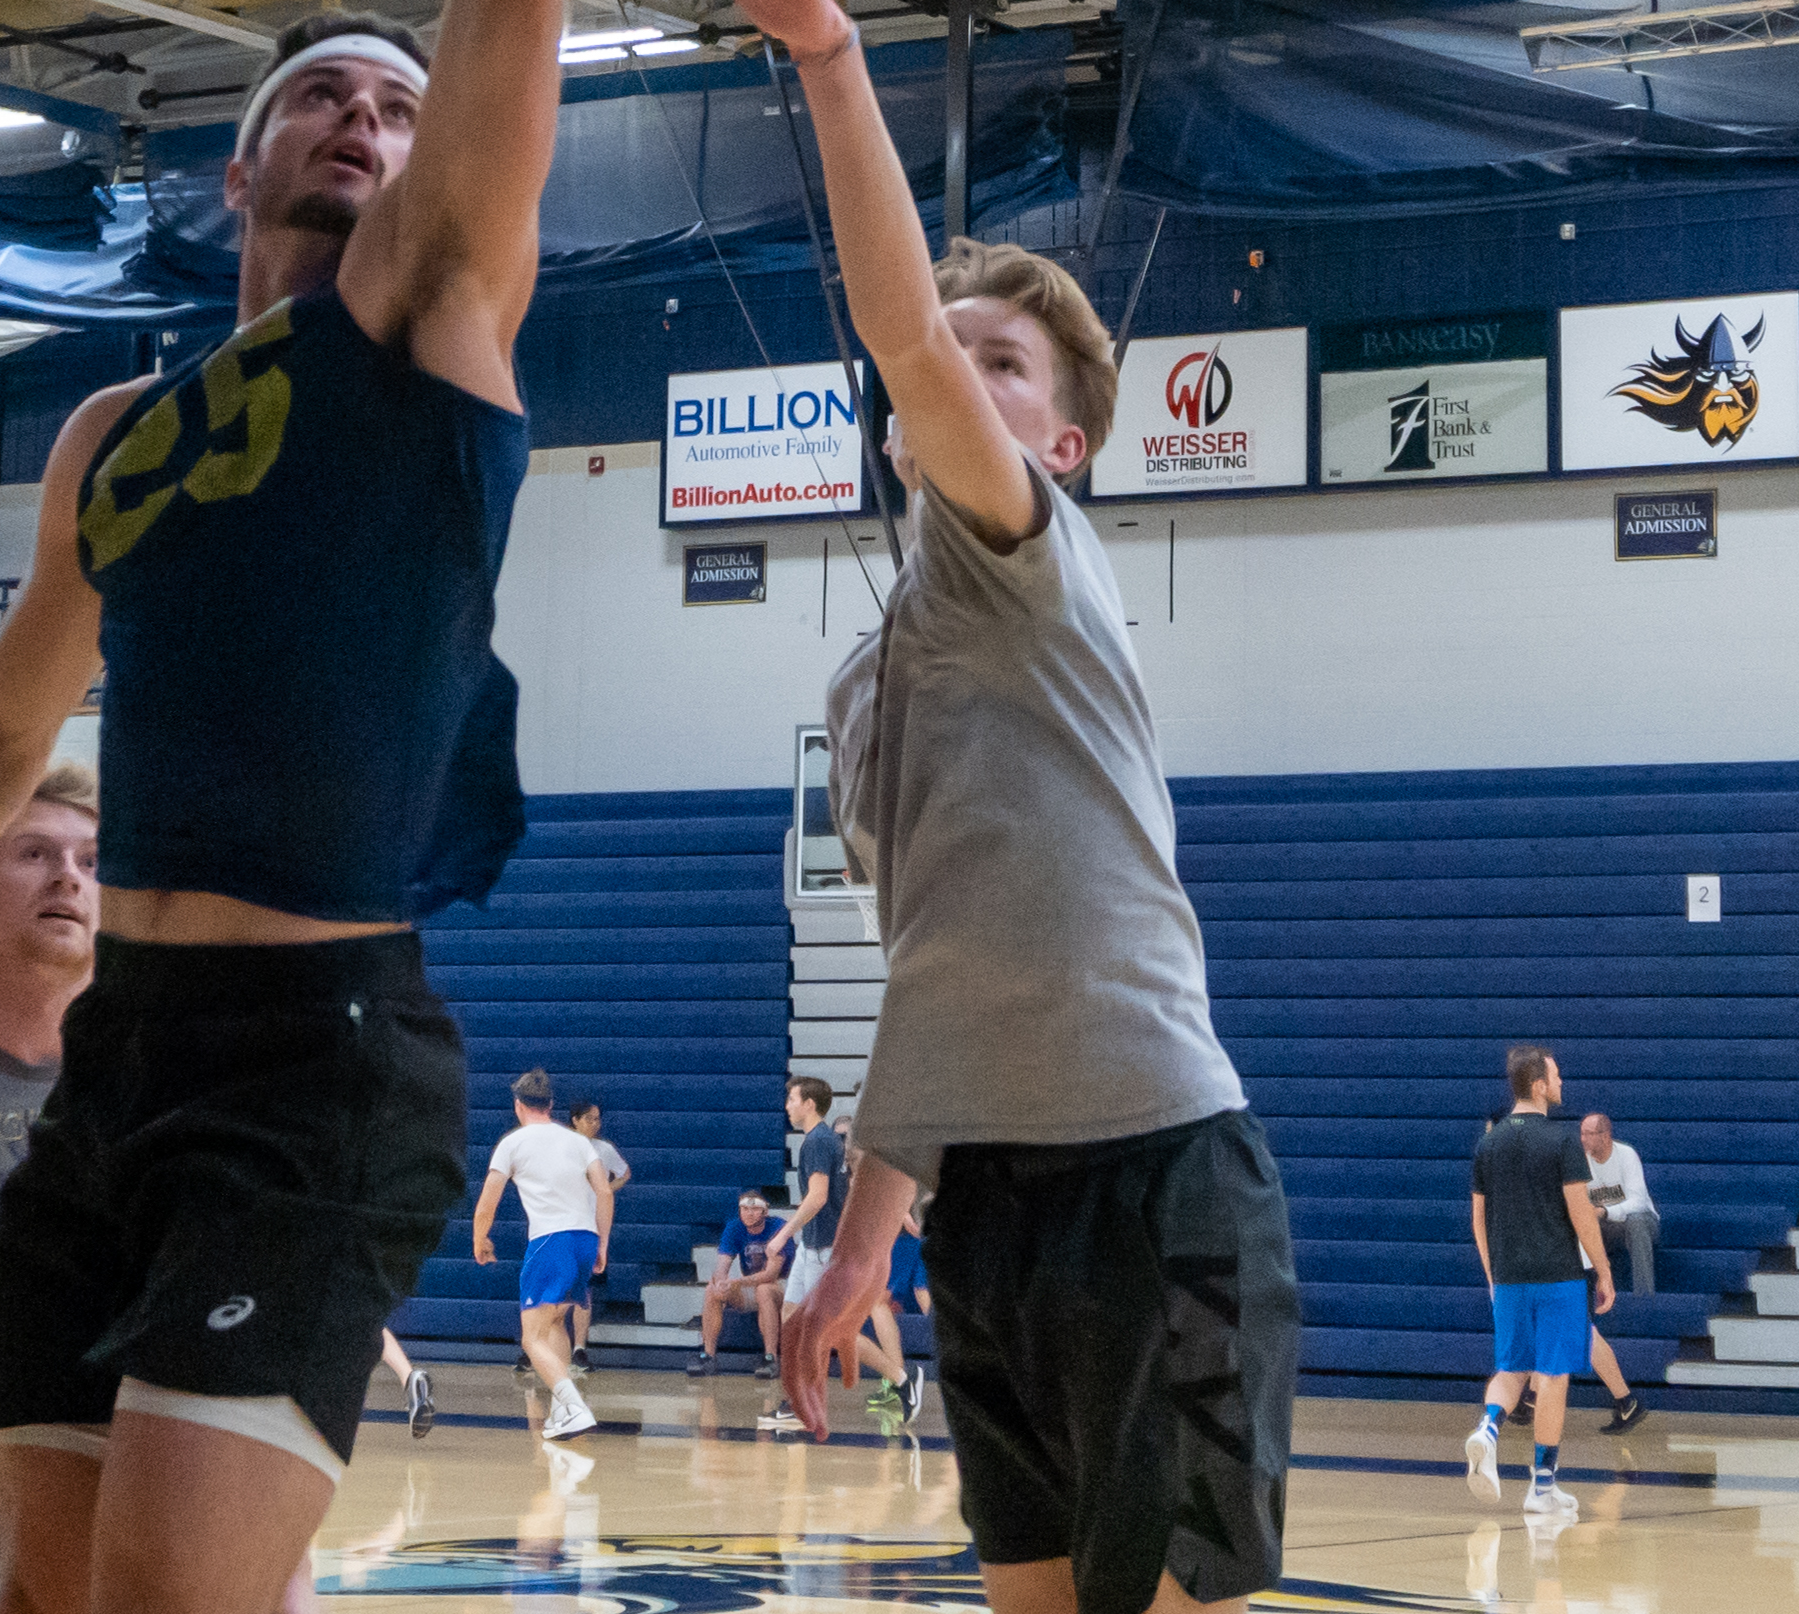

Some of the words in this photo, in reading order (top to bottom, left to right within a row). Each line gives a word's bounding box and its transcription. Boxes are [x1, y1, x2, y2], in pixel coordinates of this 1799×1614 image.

[673, 389, 856, 438] BILLION
[1432, 397, 1470, 416] First
[1433, 418, 1477, 437] Bank
[1480, 420, 1492, 435] &
[685, 440, 780, 463] Automotive
[785, 436, 842, 458] Family
[1142, 431, 1247, 457] WEISSER
[1432, 440, 1475, 459] Trust
[1146, 455, 1247, 473] DISTRIBUTING
[672, 482, 854, 508] BillionAuto.com
[1631, 502, 1701, 518] GENERAL
[1625, 518, 1707, 535] ADMISSION
[696, 552, 753, 568] GENERAL
[691, 567, 759, 584] ADMISSION
[1699, 886, 1709, 903] 2
